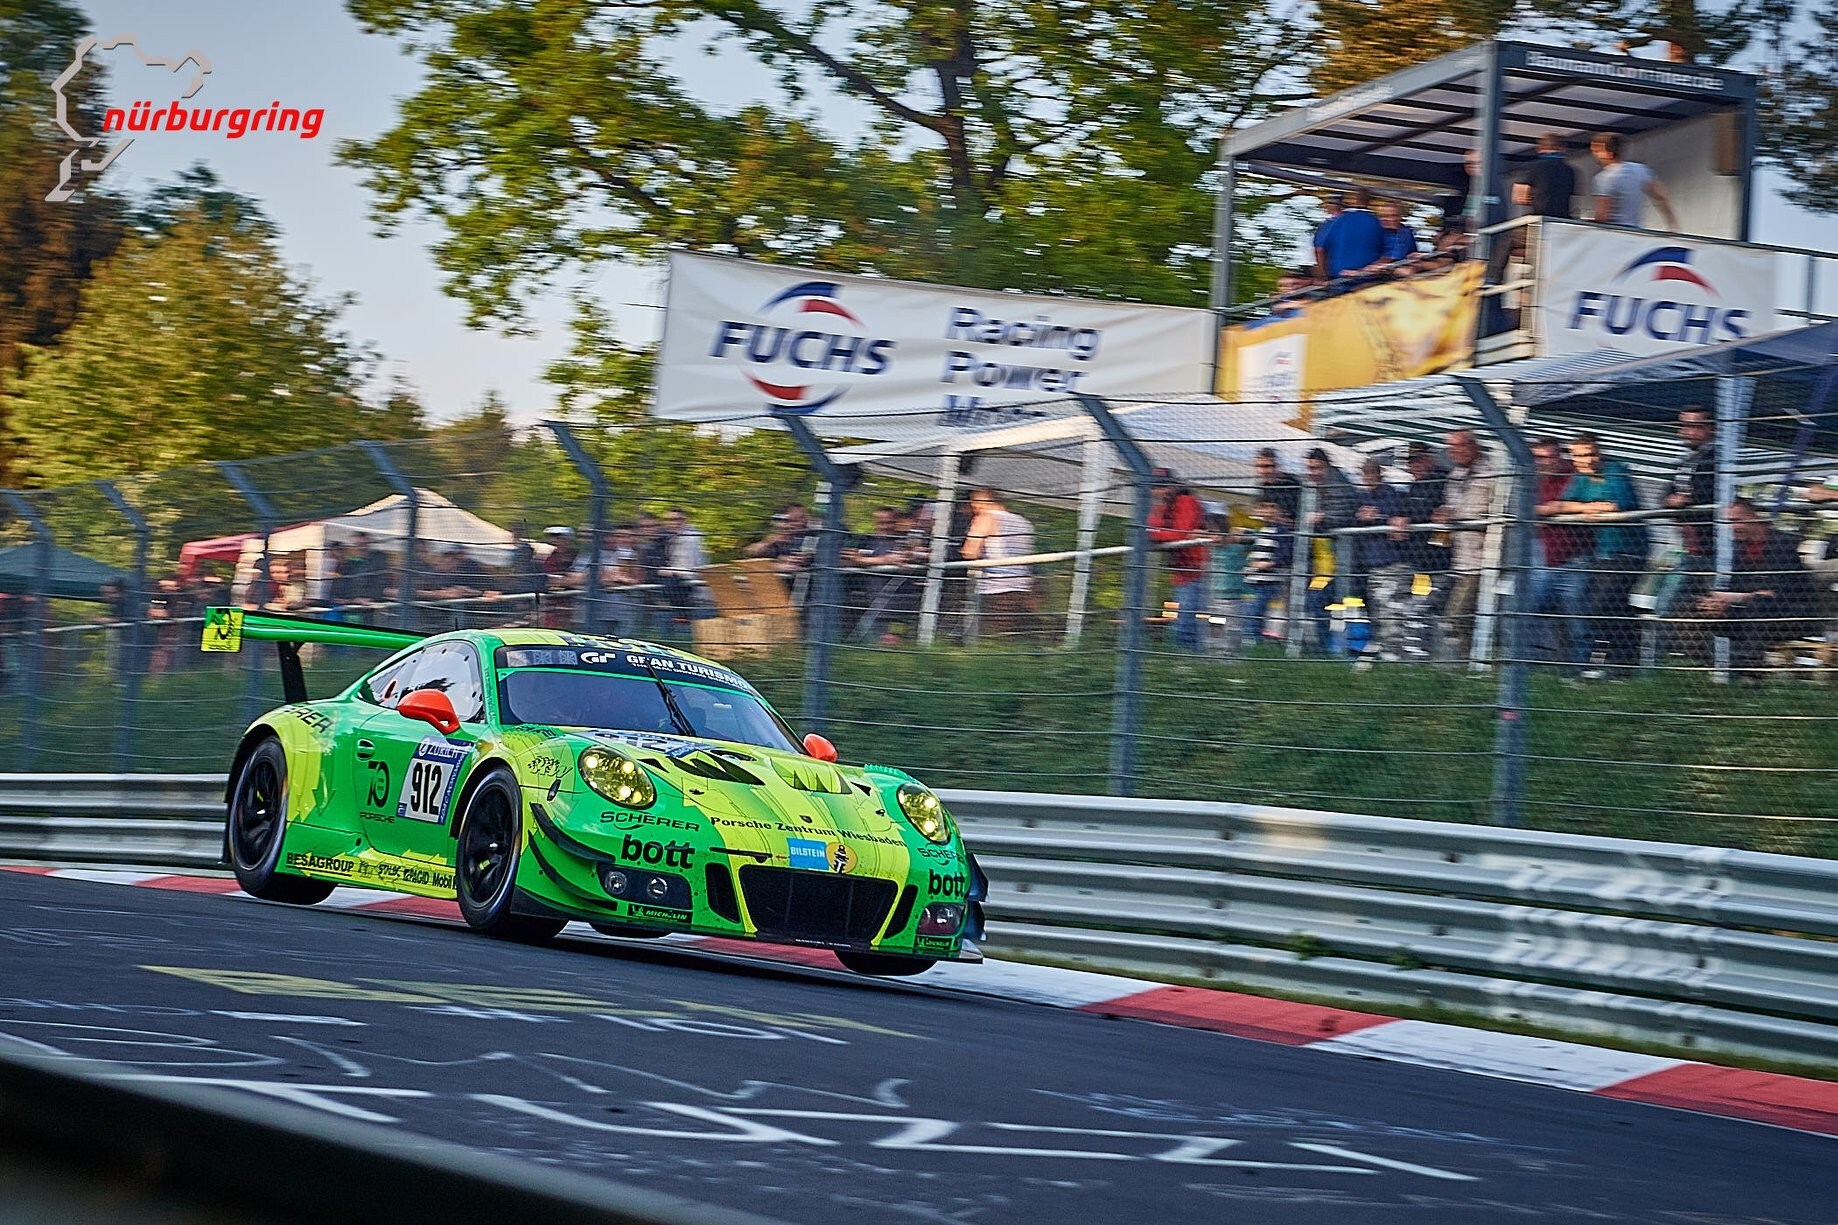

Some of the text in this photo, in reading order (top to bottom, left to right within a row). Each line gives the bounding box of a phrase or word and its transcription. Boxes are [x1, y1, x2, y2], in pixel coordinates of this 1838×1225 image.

[946, 305, 1101, 361] Racing
[1568, 290, 1752, 346] FUCHS
[710, 320, 897, 376] FUCHS
[940, 350, 1088, 392] Power
[677, 662, 746, 689] TURISMO
[411, 762, 442, 816] 912
[600, 811, 700, 832] SCHERER
[710, 817, 908, 847] Porsche Zentrum Wiesbaden
[287, 853, 354, 872] BESAGROUP
[620, 834, 695, 869] bott
[790, 846, 825, 858] BILSTEIN
[928, 869, 967, 898] bott
